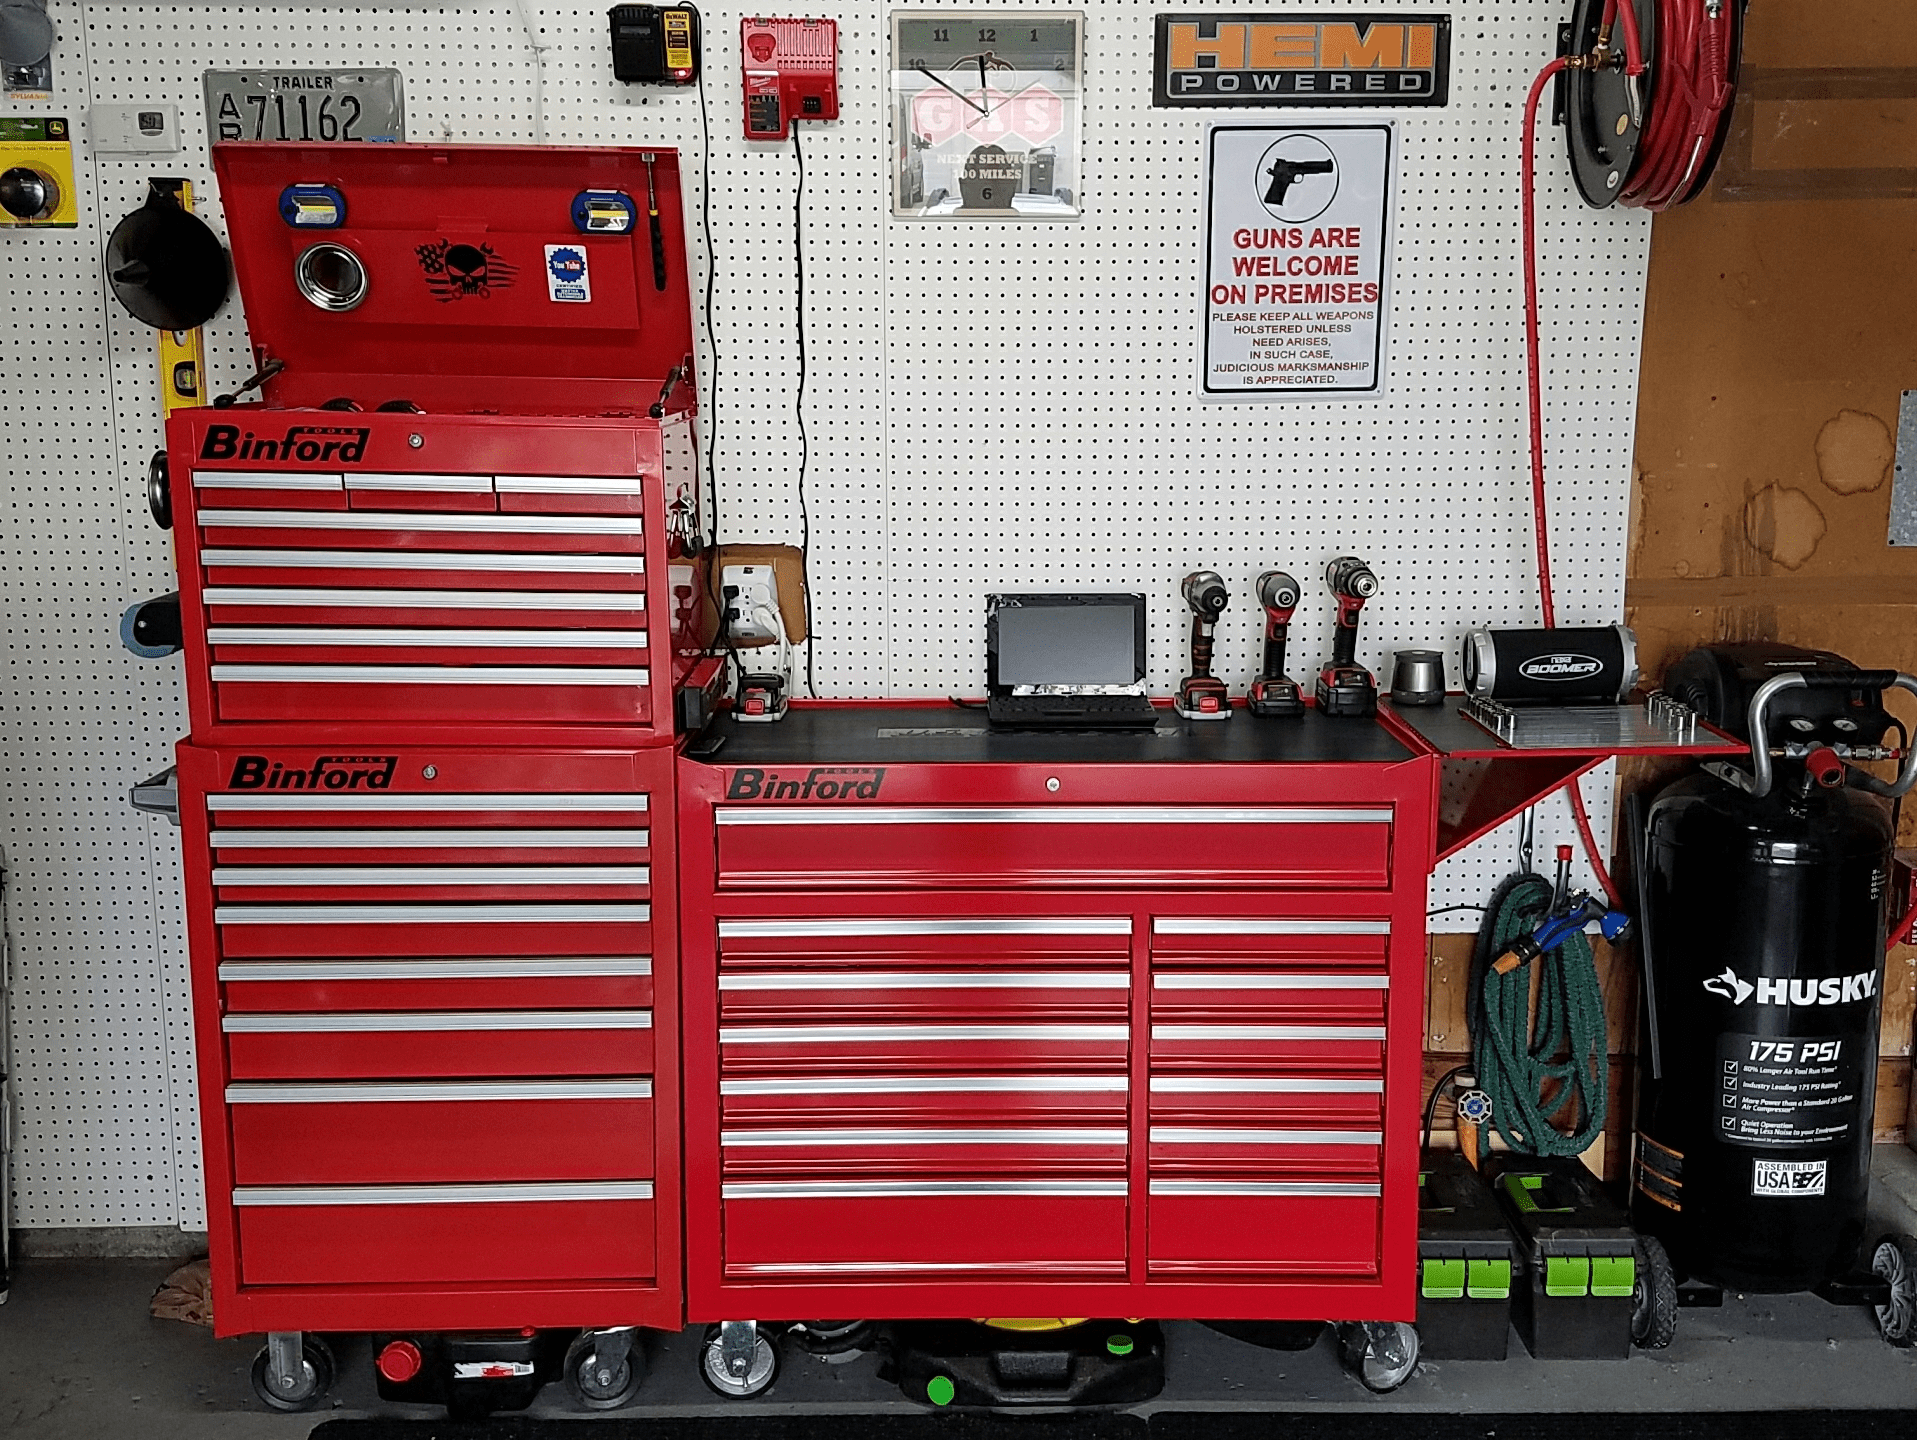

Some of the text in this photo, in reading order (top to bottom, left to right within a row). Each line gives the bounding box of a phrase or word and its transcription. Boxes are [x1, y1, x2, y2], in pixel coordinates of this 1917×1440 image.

[934, 29, 1038, 42] 11 12 1
[1169, 23, 1436, 70] HEMI
[273, 76, 334, 90] TRAILER
[1181, 74, 1422, 92] POWERED
[247, 95, 363, 142] 71162
[919, 97, 1050, 132] GAS
[937, 154, 1038, 164] NEXT SERVICE
[979, 169, 1022, 179] MILES
[982, 188, 993, 200] 6
[1233, 227, 1361, 249] GUNS ARE
[1232, 255, 1359, 277] WELCOME
[1211, 283, 1378, 304] ON PREMISES
[1212, 311, 1374, 322] PLEASE KEEP ALL WEAPONS
[1234, 324, 1352, 334] HOLSTERED UNLESS
[1252, 337, 1331, 347] NEED ARISES,
[1250, 350, 1333, 360] IN SUCH CASE,
[1212, 362, 1370, 372] JUDICIOUS MARKSMANSHIP
[1243, 375, 1338, 384] IS APPRECIATED.
[200, 424, 371, 463] Binford
[1526, 662, 1597, 674] BOOMER
[228, 755, 398, 789] Binford
[726, 768, 887, 800] Binford
[1750, 1040, 1842, 1063] 175 PSI
[1760, 1066, 1782, 1076] Longer
[1742, 1081, 1770, 1091] Industry
[1771, 1084, 1797, 1092] Leading
[1742, 1096, 1760, 1104] More
[1803, 1098, 1830, 1106] Standard
[1760, 1121, 1794, 1129] Operation
[1757, 1162, 1813, 1172] ASSEMBLED
[1757, 1170, 1790, 1188] USA
